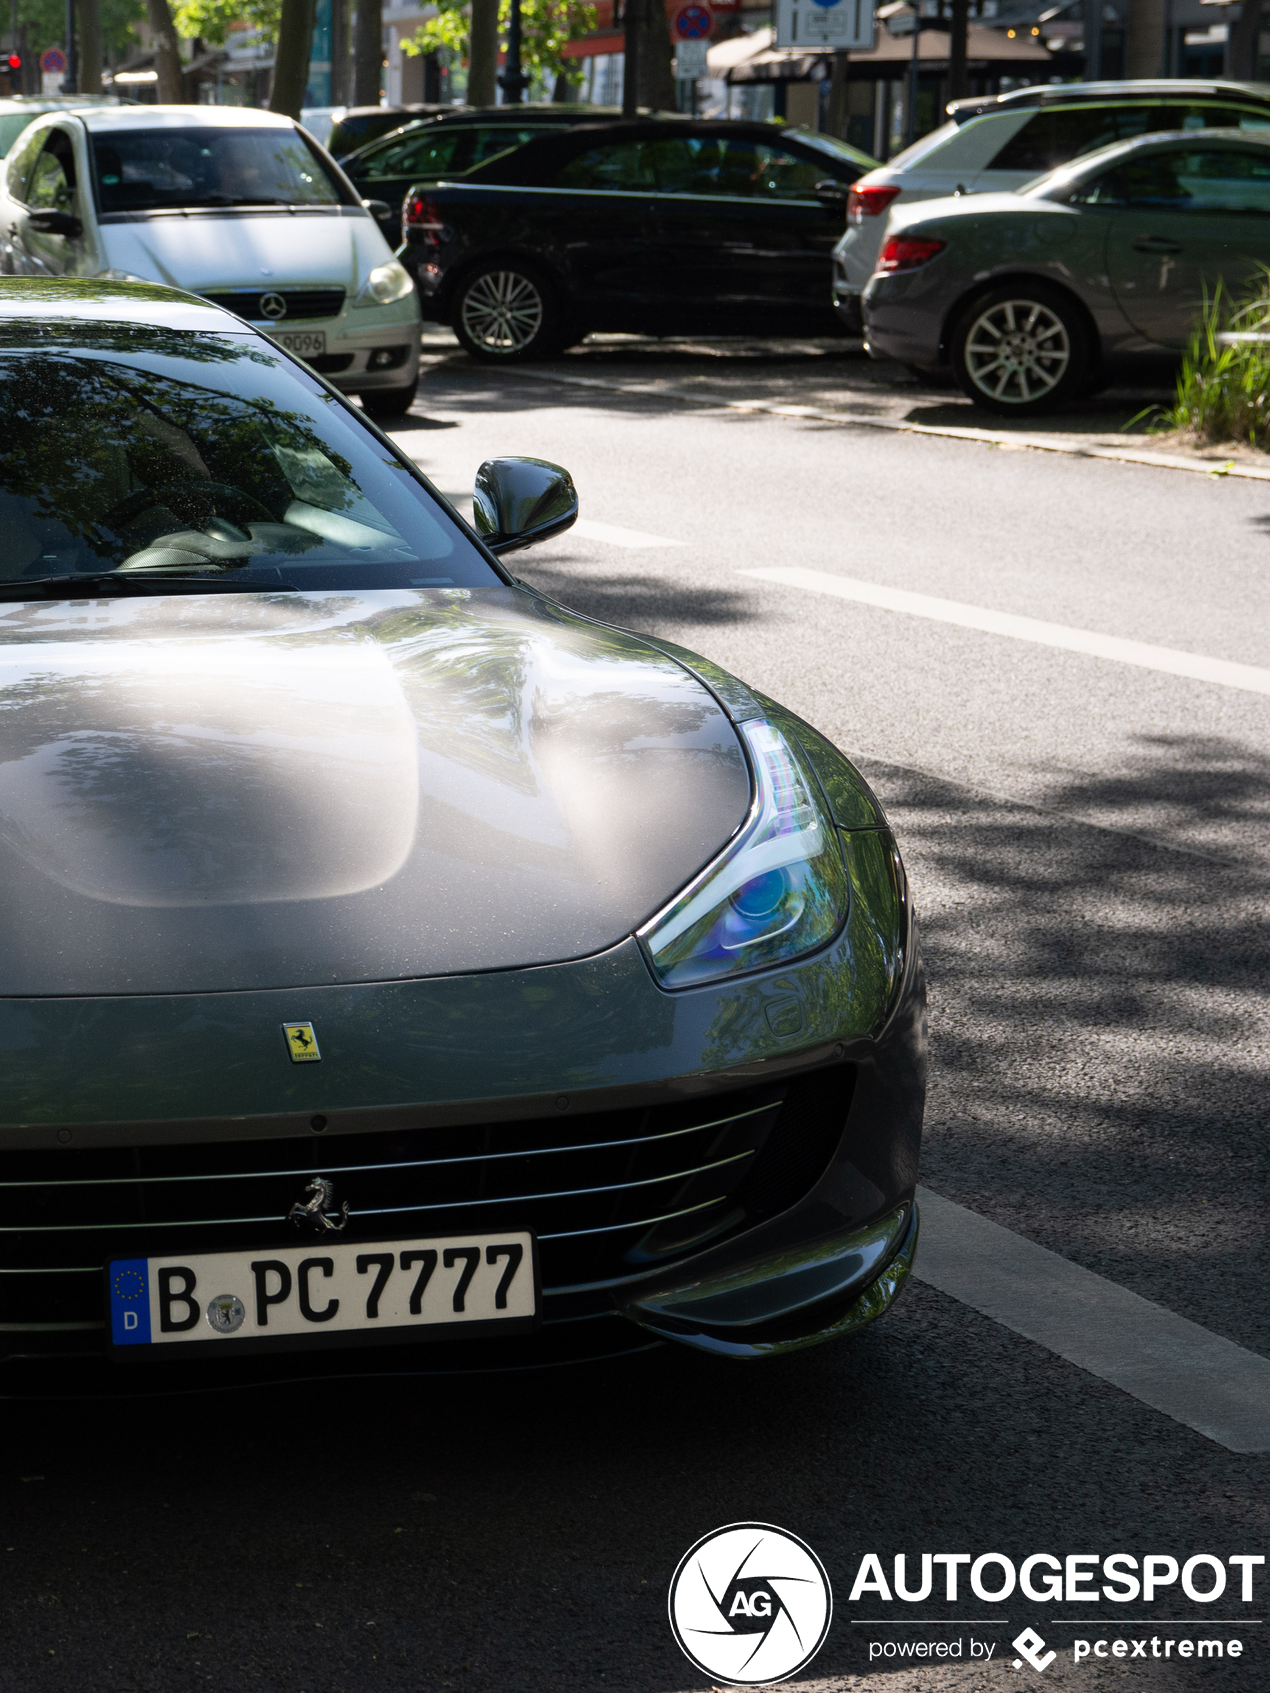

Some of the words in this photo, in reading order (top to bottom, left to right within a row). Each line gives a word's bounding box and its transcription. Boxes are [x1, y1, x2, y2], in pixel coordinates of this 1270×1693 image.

[284, 336, 321, 351] 9096
[158, 1266, 200, 1333] B
[250, 1257, 340, 1327] PC
[356, 1243, 524, 1319] 7777
[123, 1311, 138, 1330] D
